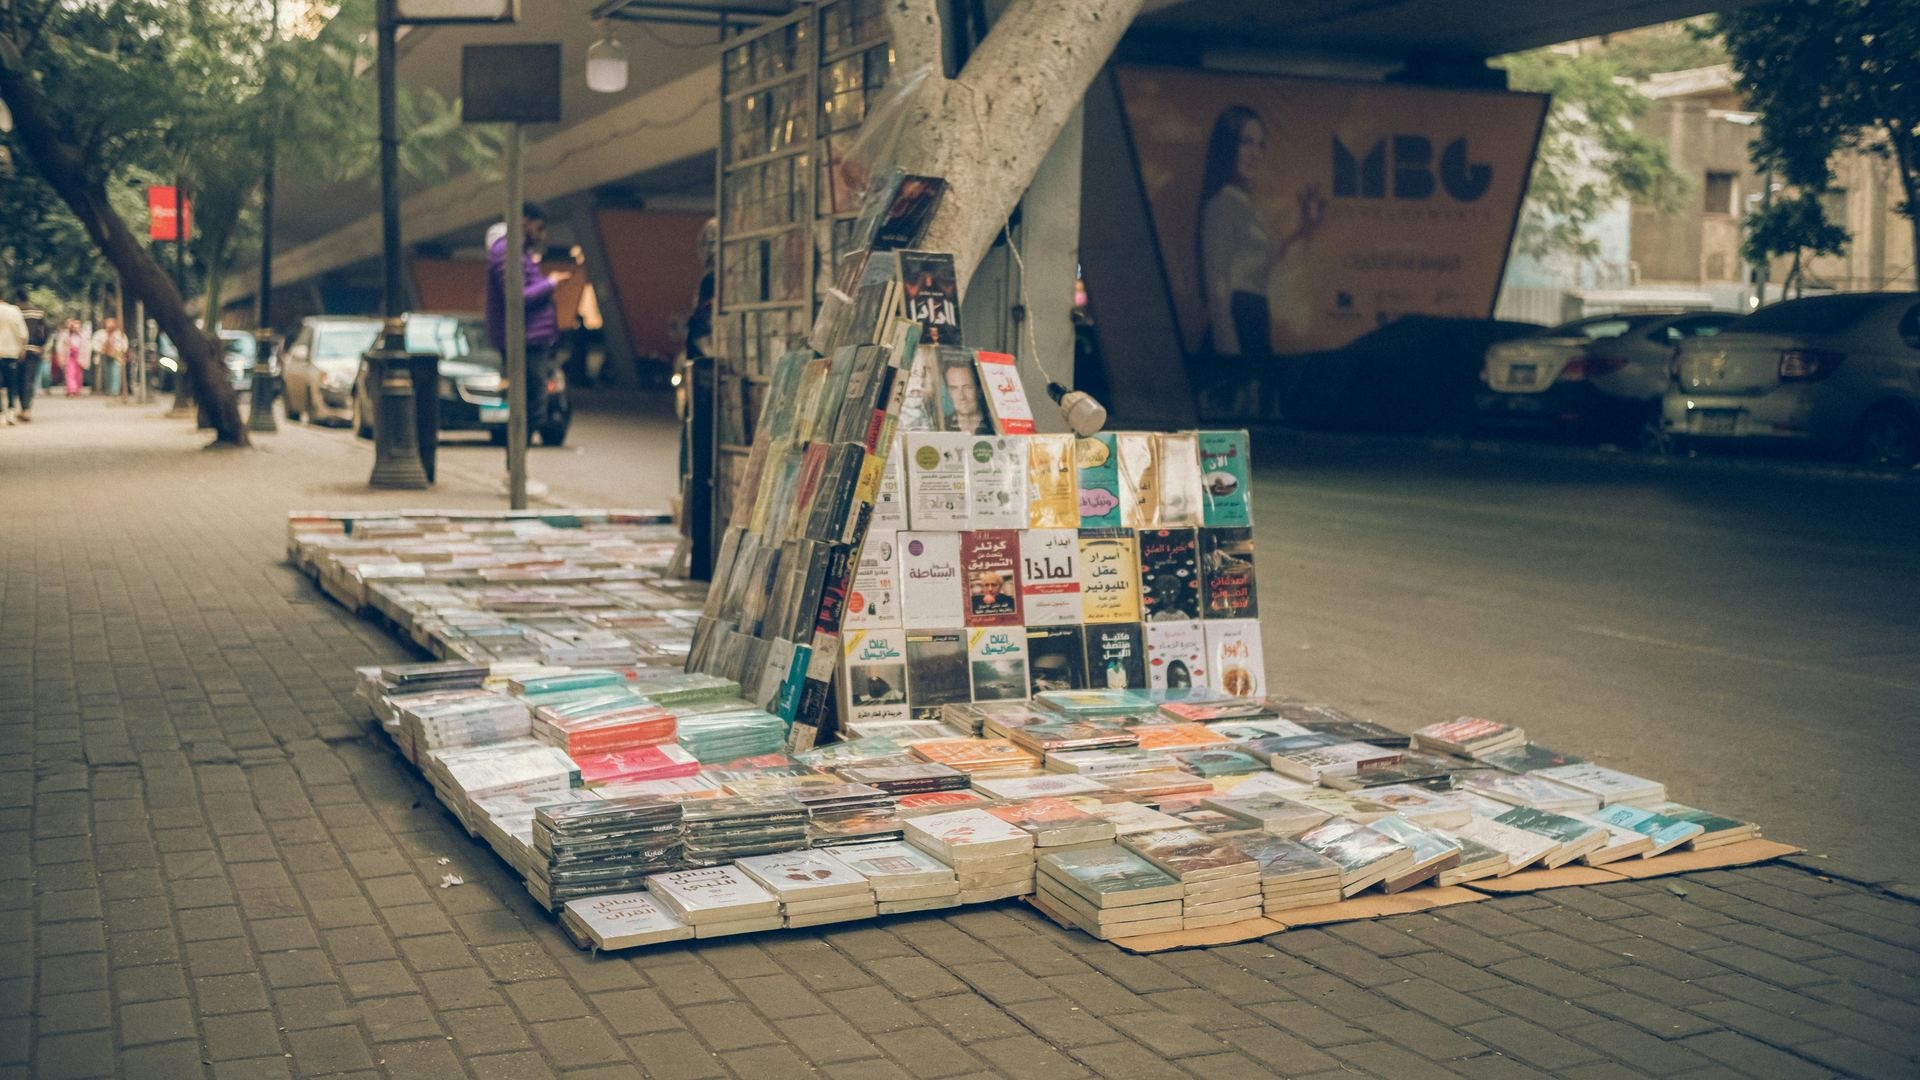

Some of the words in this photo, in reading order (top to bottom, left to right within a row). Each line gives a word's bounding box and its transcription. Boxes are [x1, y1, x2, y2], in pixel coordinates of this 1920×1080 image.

[1331, 131, 1493, 203] MBG
[972, 540, 1006, 553] كوتلر
[1090, 548, 1120, 562] أسرار
[967, 558, 1013, 570] التسويق
[1024, 556, 1073, 580] لماذا
[909, 567, 955, 580] البساطة
[1092, 565, 1118, 577] عقل
[1084, 580, 1129, 593] المليونير
[1101, 632, 1130, 641] مكتبة
[1102, 641, 1131, 649] منتصف
[1103, 649, 1131, 660] الليل
